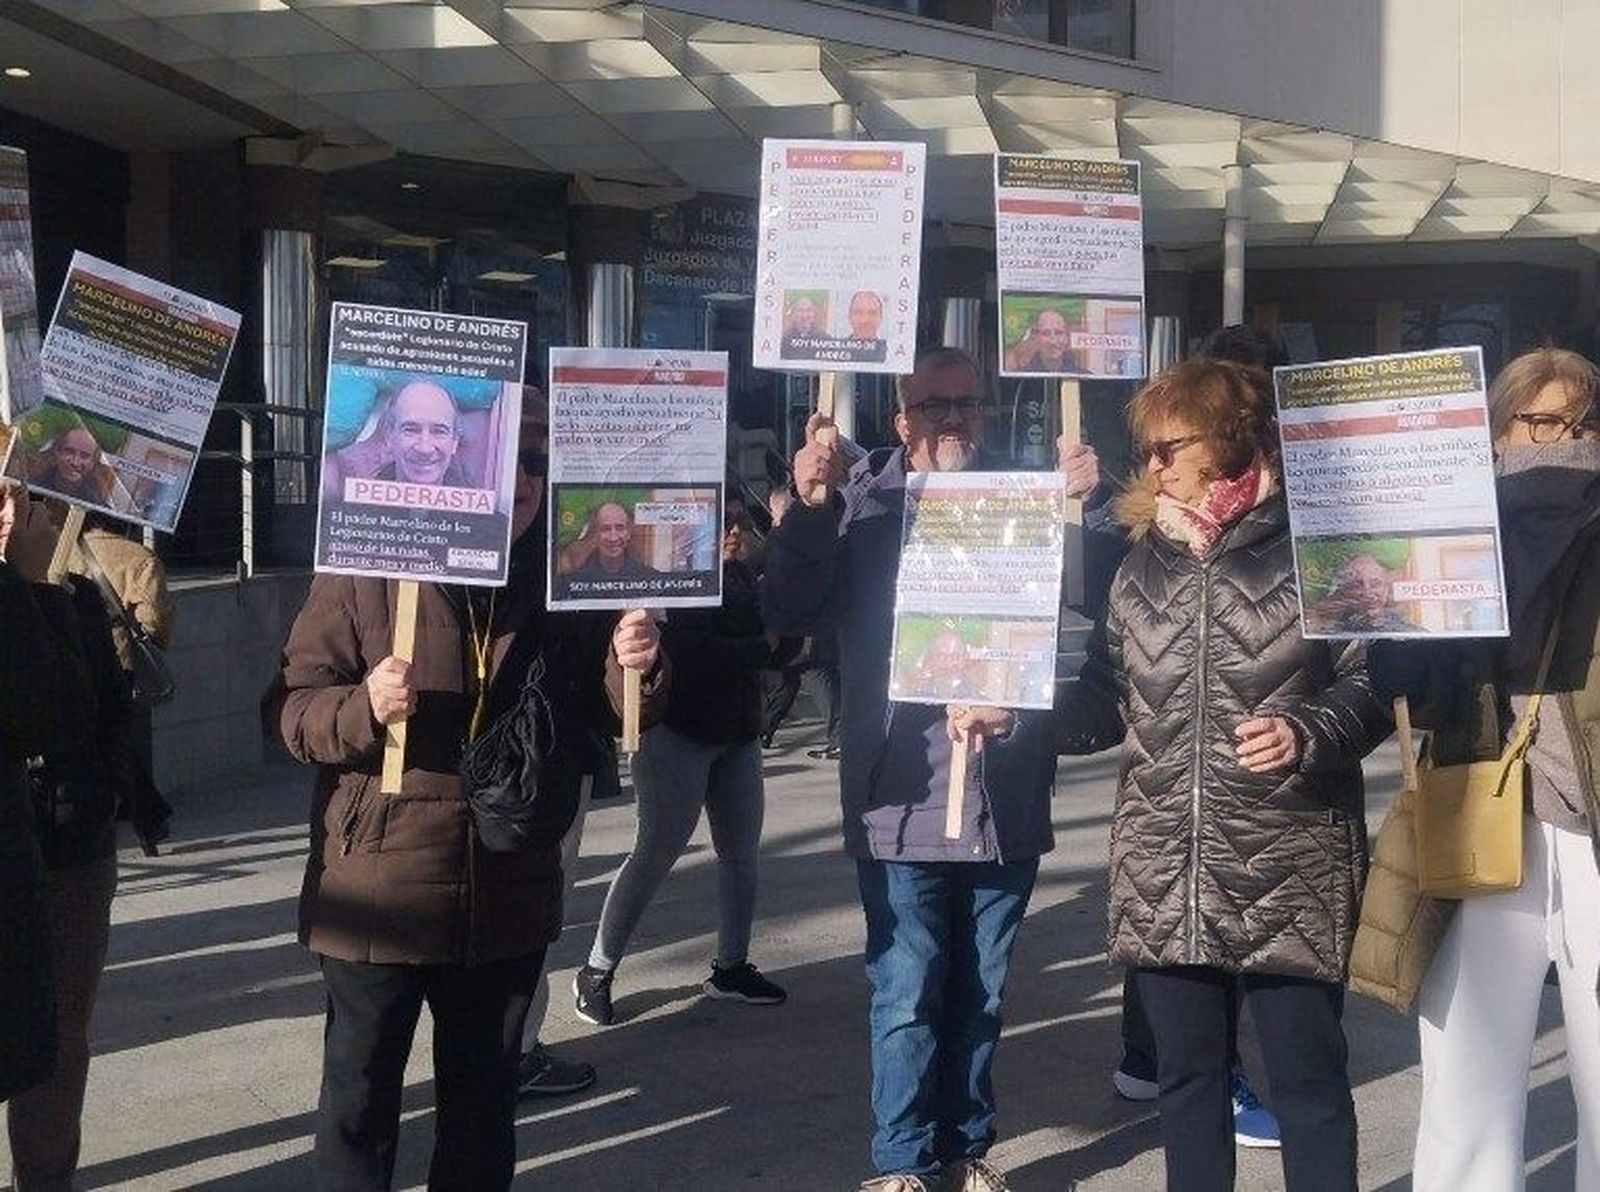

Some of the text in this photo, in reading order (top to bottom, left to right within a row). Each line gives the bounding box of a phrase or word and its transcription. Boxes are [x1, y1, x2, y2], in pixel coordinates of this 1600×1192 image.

[690, 230, 757, 250] Juzgado
[339, 307, 521, 339] MARCELINO DE ANDRÉS
[1290, 364, 1375, 383] MARCELINO
[1379, 361, 1398, 375] DE
[355, 482, 491, 511] PEDERASTA
[345, 512, 378, 527] padre
[380, 515, 438, 530] Marcelino
[438, 520, 452, 530] de
[455, 521, 471, 534] los
[397, 531, 410, 542] de
[1401, 583, 1487, 597] PEDERASTA
